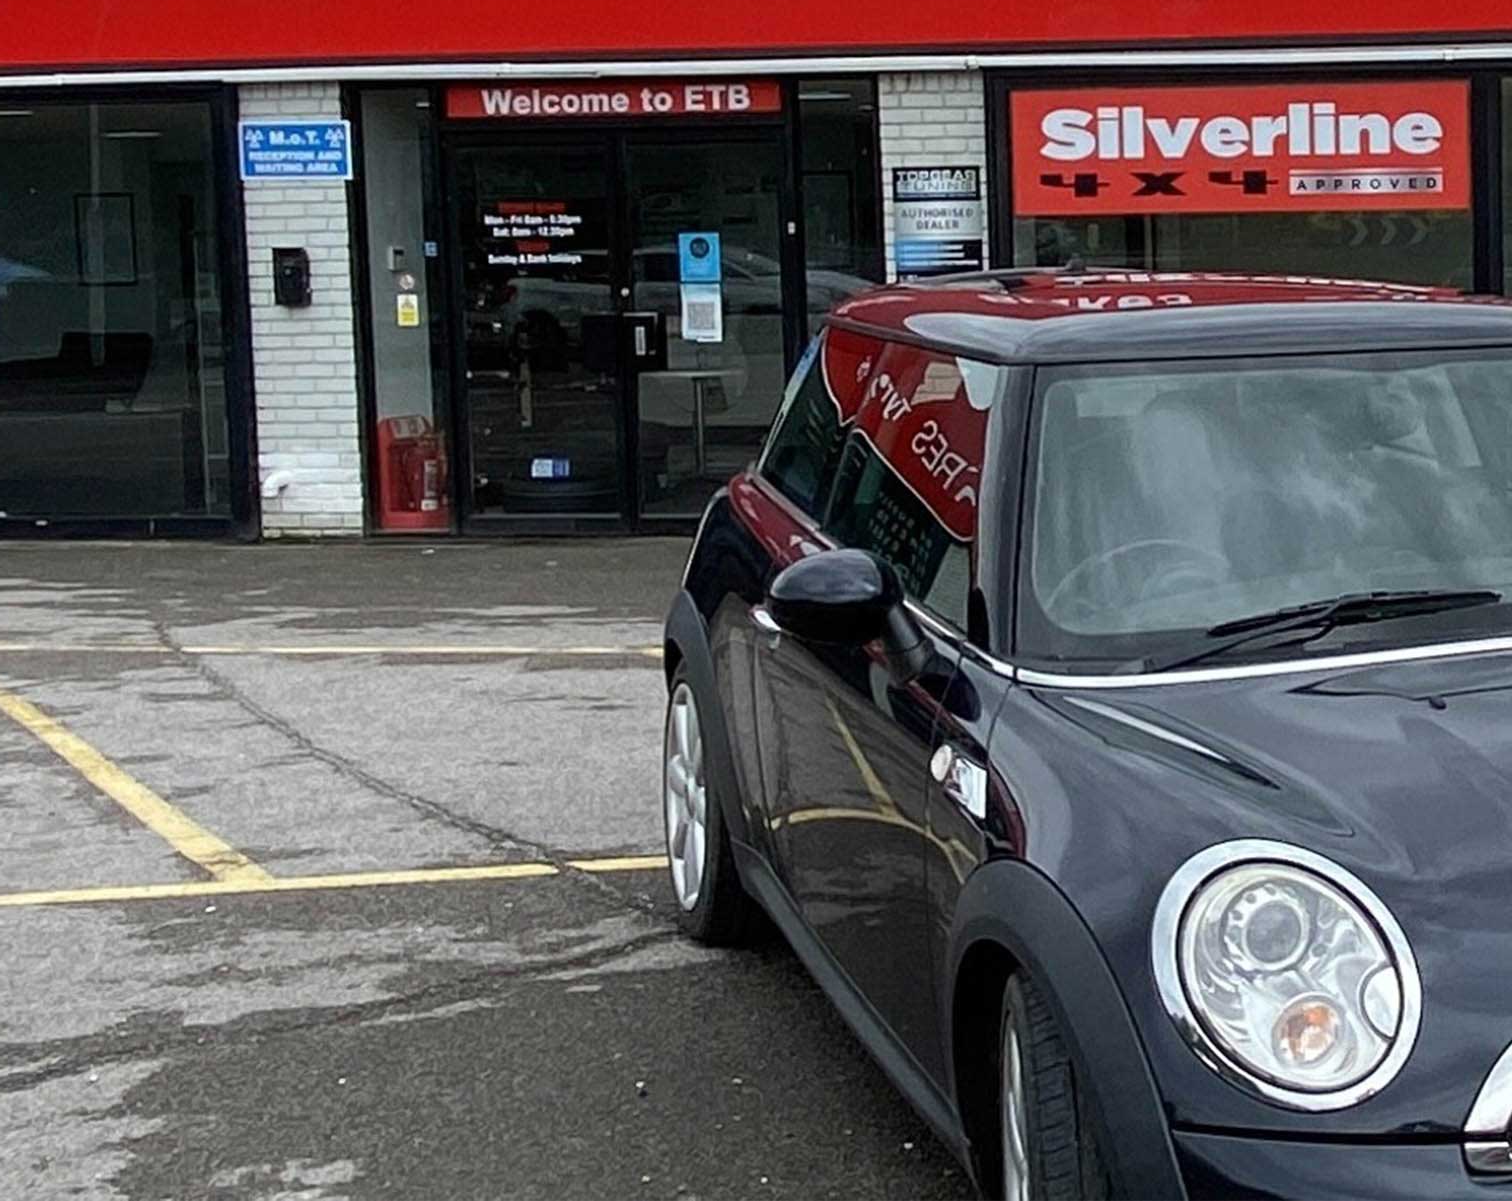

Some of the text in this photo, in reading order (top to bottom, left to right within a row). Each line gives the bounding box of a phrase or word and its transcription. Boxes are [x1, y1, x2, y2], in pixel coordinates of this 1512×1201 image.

[481, 84, 751, 115] Welcome to ETB
[1040, 102, 1443, 161] Silverline
[1296, 177, 1438, 192] APPROVED
[900, 207, 974, 219] AUTHORISED
[916, 220, 959, 230] DEALER
